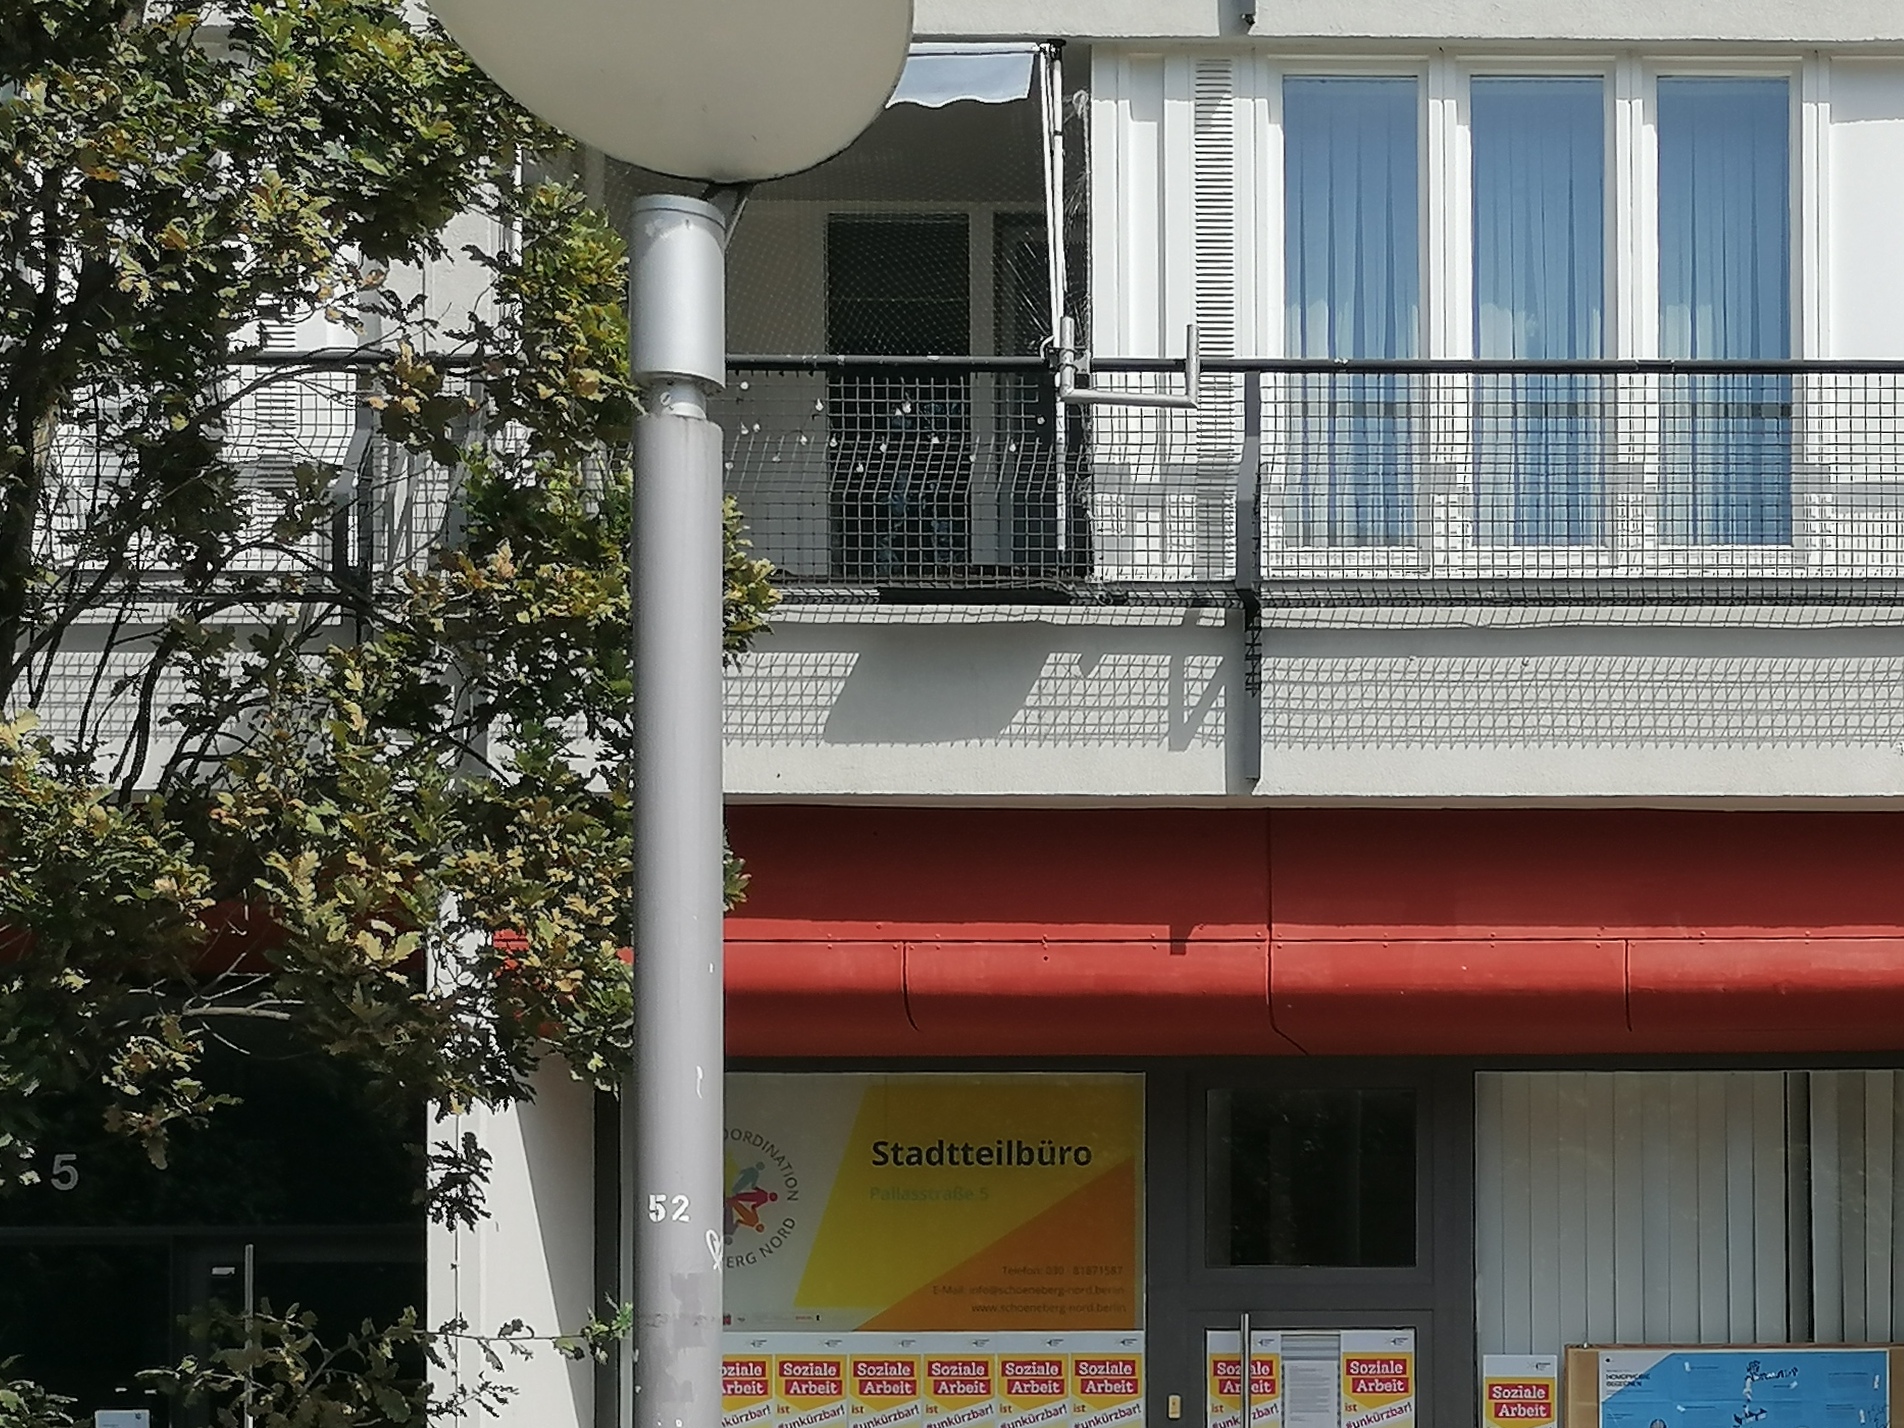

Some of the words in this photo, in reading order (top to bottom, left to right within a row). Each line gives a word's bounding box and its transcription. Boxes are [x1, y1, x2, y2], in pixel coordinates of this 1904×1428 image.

[872, 1140, 1092, 1166] Stadtteilbüro
[51, 1154, 79, 1191] 5
[649, 1194, 690, 1222] 52
[783, 1363, 837, 1377] Soziale
[857, 1363, 911, 1377] Soziale
[931, 1362, 985, 1376] Soziale
[1005, 1362, 1059, 1376] Soziale
[1079, 1362, 1133, 1376] Soziale
[1350, 1360, 1403, 1375] Soziale
[789, 1381, 838, 1395] Arbeit
[863, 1381, 912, 1395] Arbeit
[937, 1380, 986, 1394] Arbeit
[1011, 1380, 1060, 1394] Arbeit
[1085, 1380, 1134, 1394] Arbeit
[1356, 1380, 1404, 1393] Arbeit
[1492, 1385, 1545, 1399] Soziale
[1498, 1404, 1547, 1418] Arbeit
